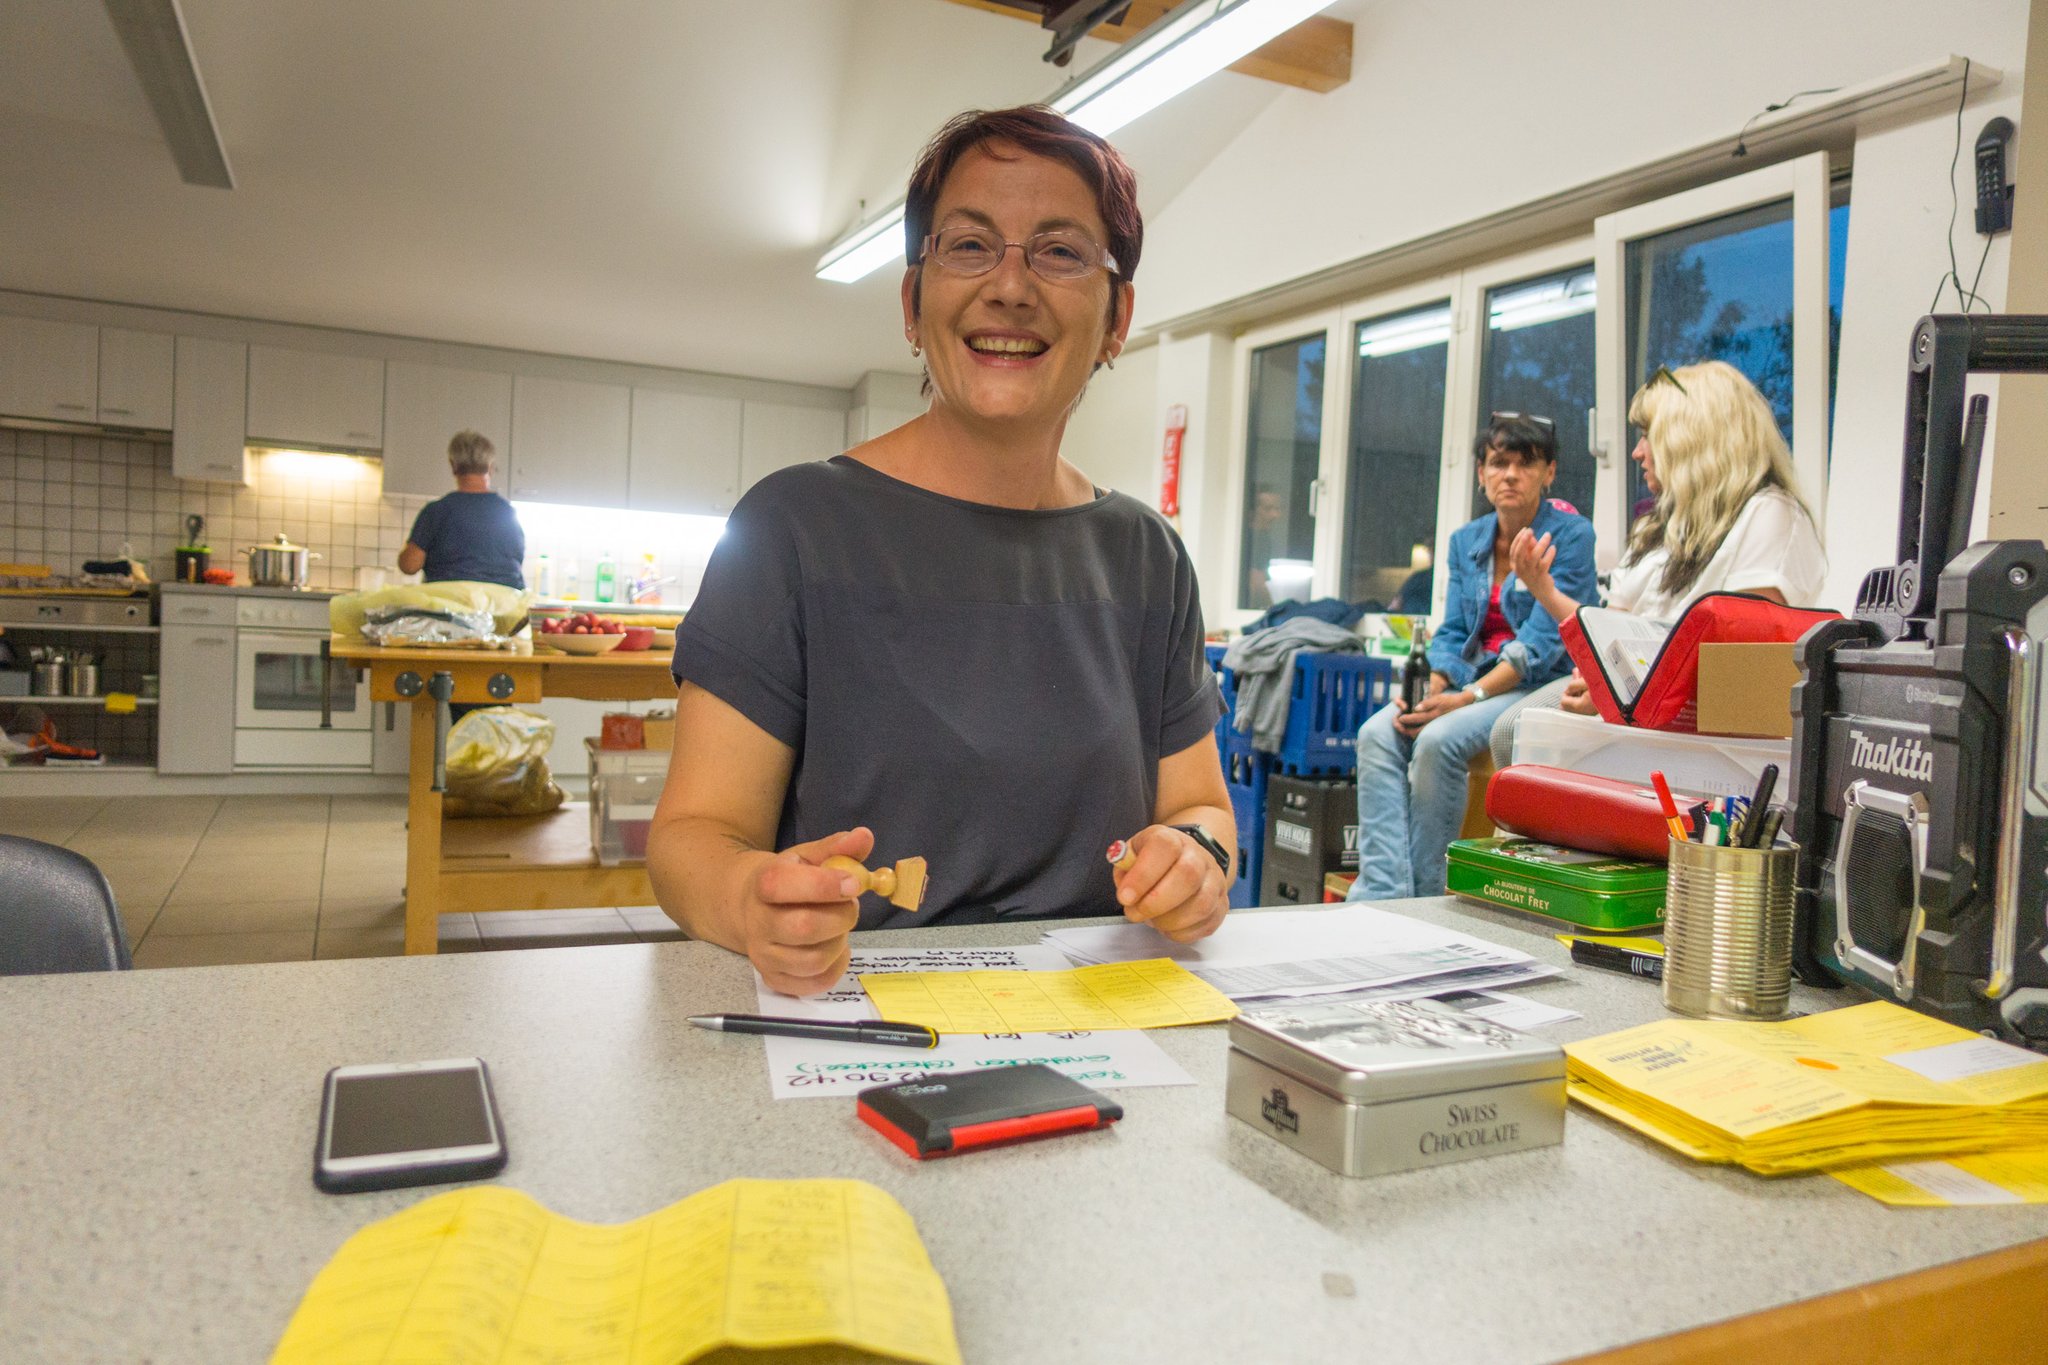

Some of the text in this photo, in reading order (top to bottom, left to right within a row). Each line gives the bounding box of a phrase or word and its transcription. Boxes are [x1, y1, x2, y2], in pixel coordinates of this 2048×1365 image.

[1484, 884, 1550, 911] CHOCOLAT FREY
[1447, 1103, 1498, 1127] SWISS
[1419, 1122, 1520, 1156] CHOCOLATE
